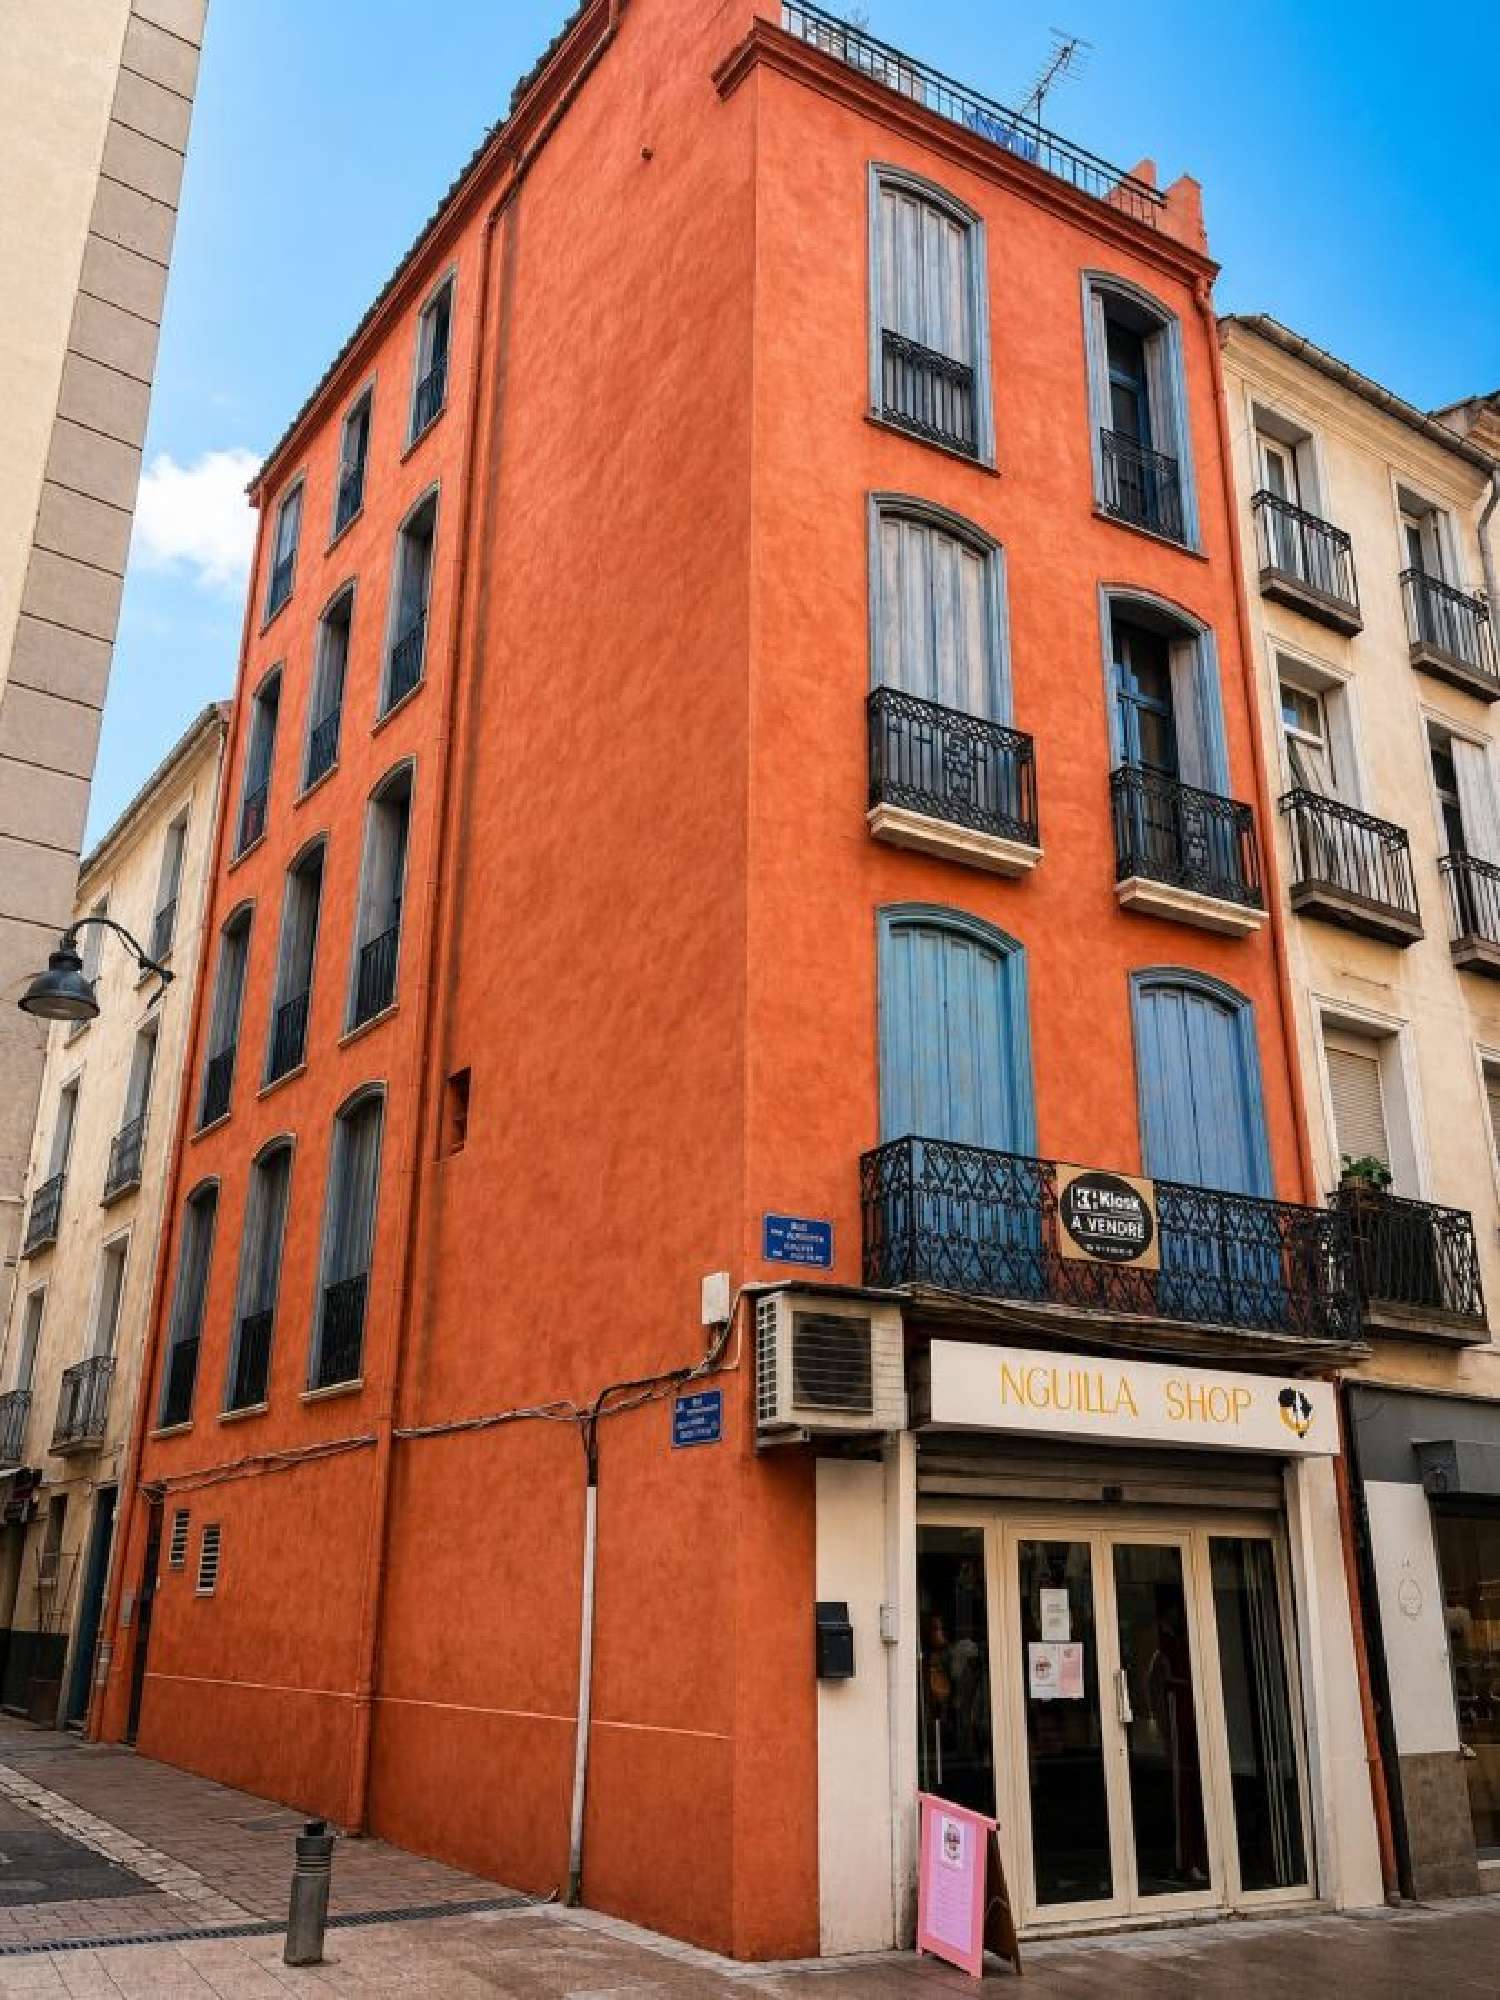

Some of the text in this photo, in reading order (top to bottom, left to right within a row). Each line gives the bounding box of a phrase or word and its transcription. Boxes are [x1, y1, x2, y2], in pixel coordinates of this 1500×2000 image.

[1087, 1217, 1145, 1239] VENDRE
[1000, 1362, 1251, 1424] NGUILLA SHOP
